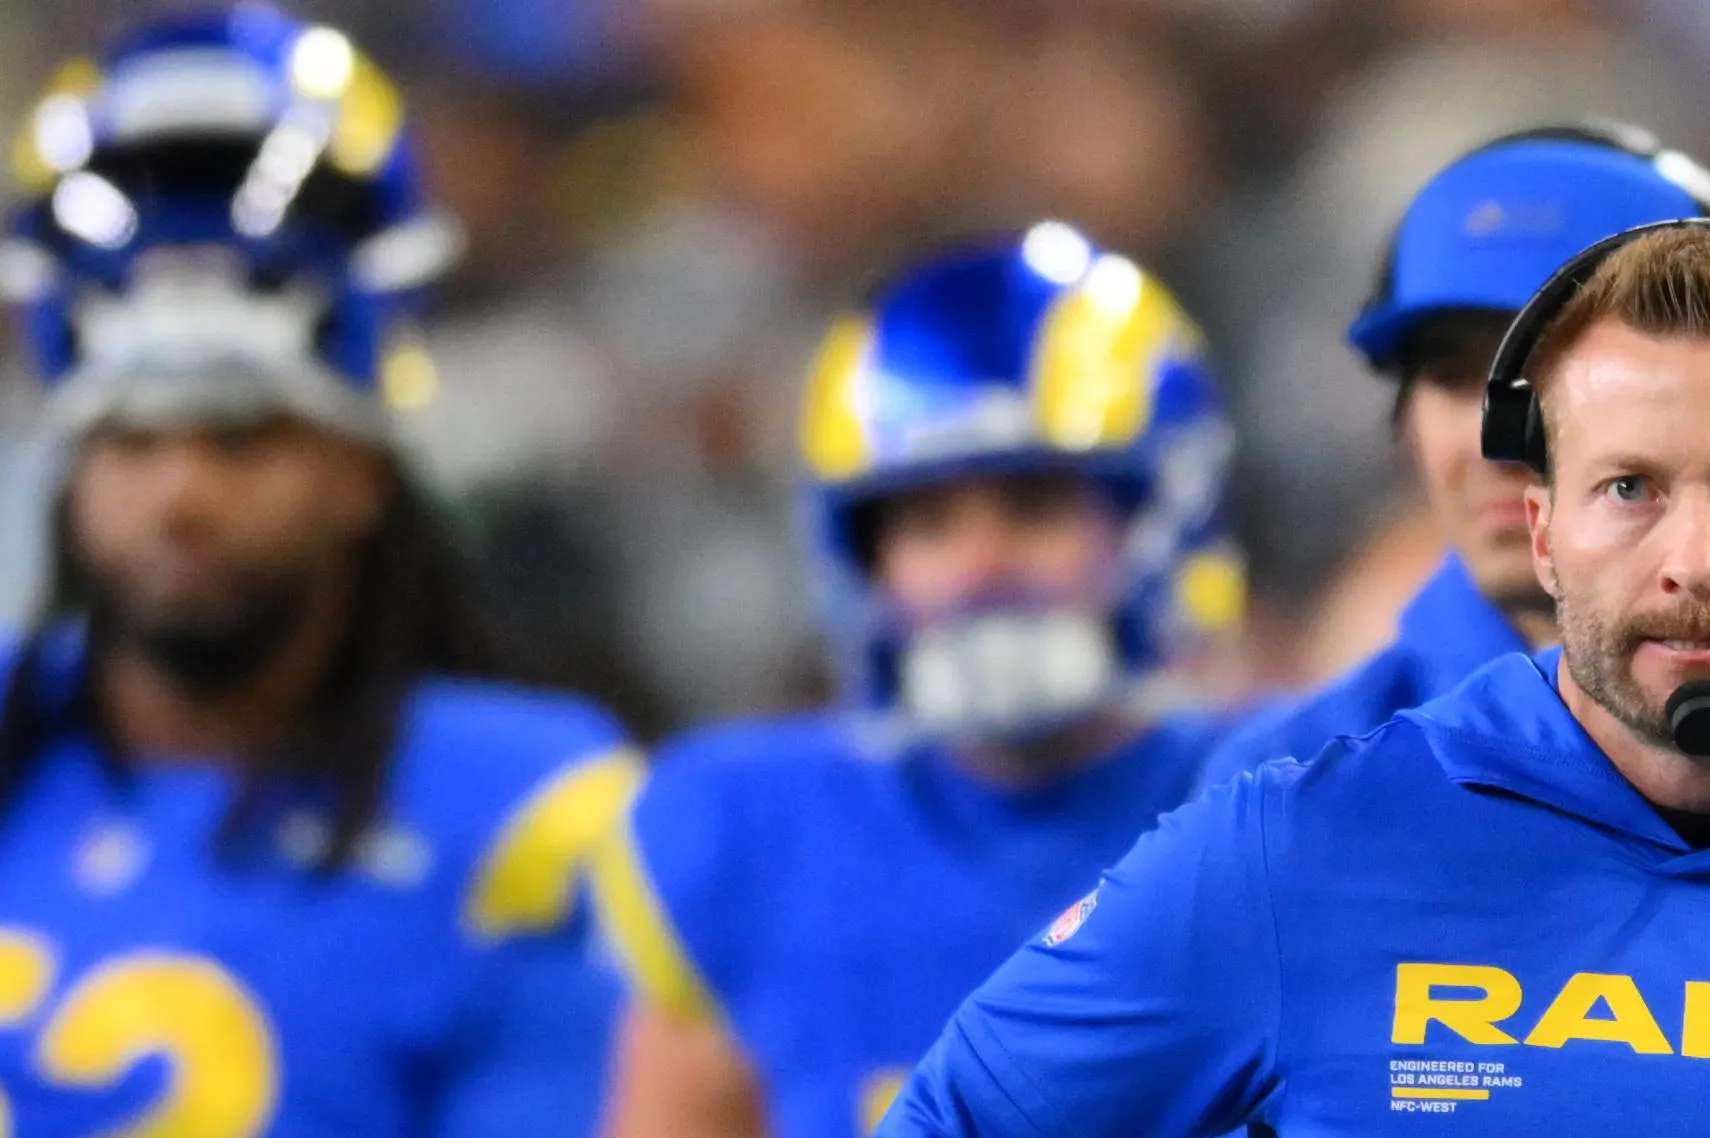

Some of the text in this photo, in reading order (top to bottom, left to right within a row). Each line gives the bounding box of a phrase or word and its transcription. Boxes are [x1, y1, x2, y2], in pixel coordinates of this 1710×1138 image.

[1389, 1060, 1505, 1074] ENGINEERED FOR
[1390, 1073, 1523, 1088] LOS ANGELES RAMS
[1390, 1100, 1457, 1113] NFC-WEST
